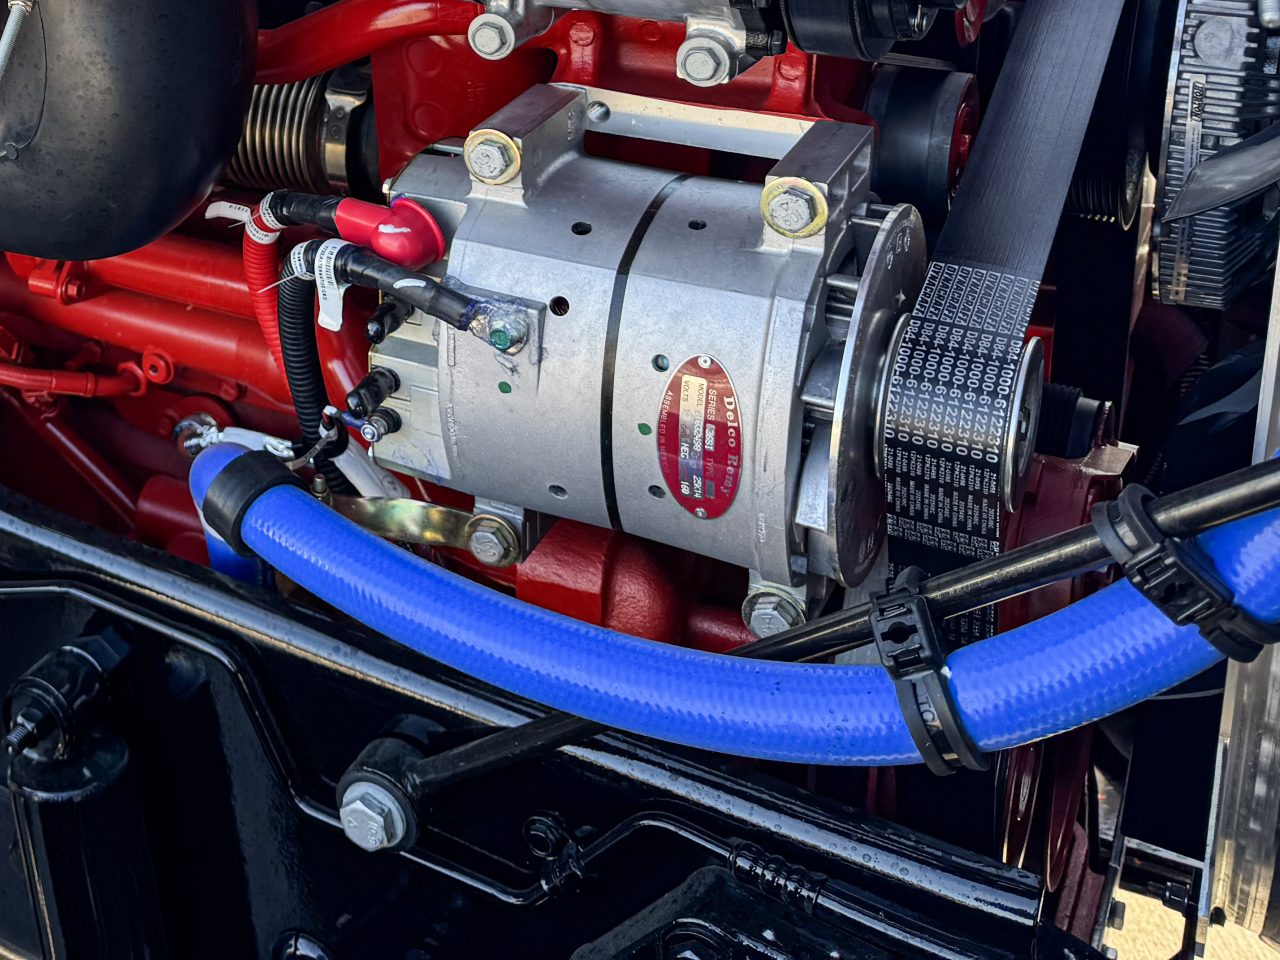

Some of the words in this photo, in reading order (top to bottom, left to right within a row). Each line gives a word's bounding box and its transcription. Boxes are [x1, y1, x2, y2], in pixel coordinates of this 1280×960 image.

[1192, 83, 1204, 122] HORTON
[914, 263, 943, 316] DYNACRAFT
[928, 266, 957, 319] DYNACRAFT
[942, 268, 971, 321] DYNACRAFT
[957, 270, 985, 324] DYNACRAFT
[971, 273, 999, 327] DYNACRAFT
[986, 276, 1013, 330] DYNACRAFT
[1000, 278, 1028, 333] DYNACRAFT
[681, 379, 690, 402] VOLTS
[695, 382, 705, 408] MODEL
[705, 388, 717, 420] SERIES
[898, 322, 935, 442] D84-1000-6122310
[912, 325, 949, 445] D84-1000-6122310
[927, 328, 964, 448] D84-1000-6122310
[941, 331, 978, 452] D84-1000-6122310
[956, 334, 993, 456] D84-1000-6122310
[971, 337, 1007, 459] D84-1000-6122310
[986, 340, 1022, 463] D84-1000-6122310
[657, 389, 674, 433] ASSEMBLED
[723, 395, 738, 448] Delco
[658, 435, 665, 444] IN
[658, 445, 668, 473] MEXICO
[703, 427, 715, 451] 36SI
[704, 456, 714, 477] TYPE
[718, 453, 739, 497] Remy
